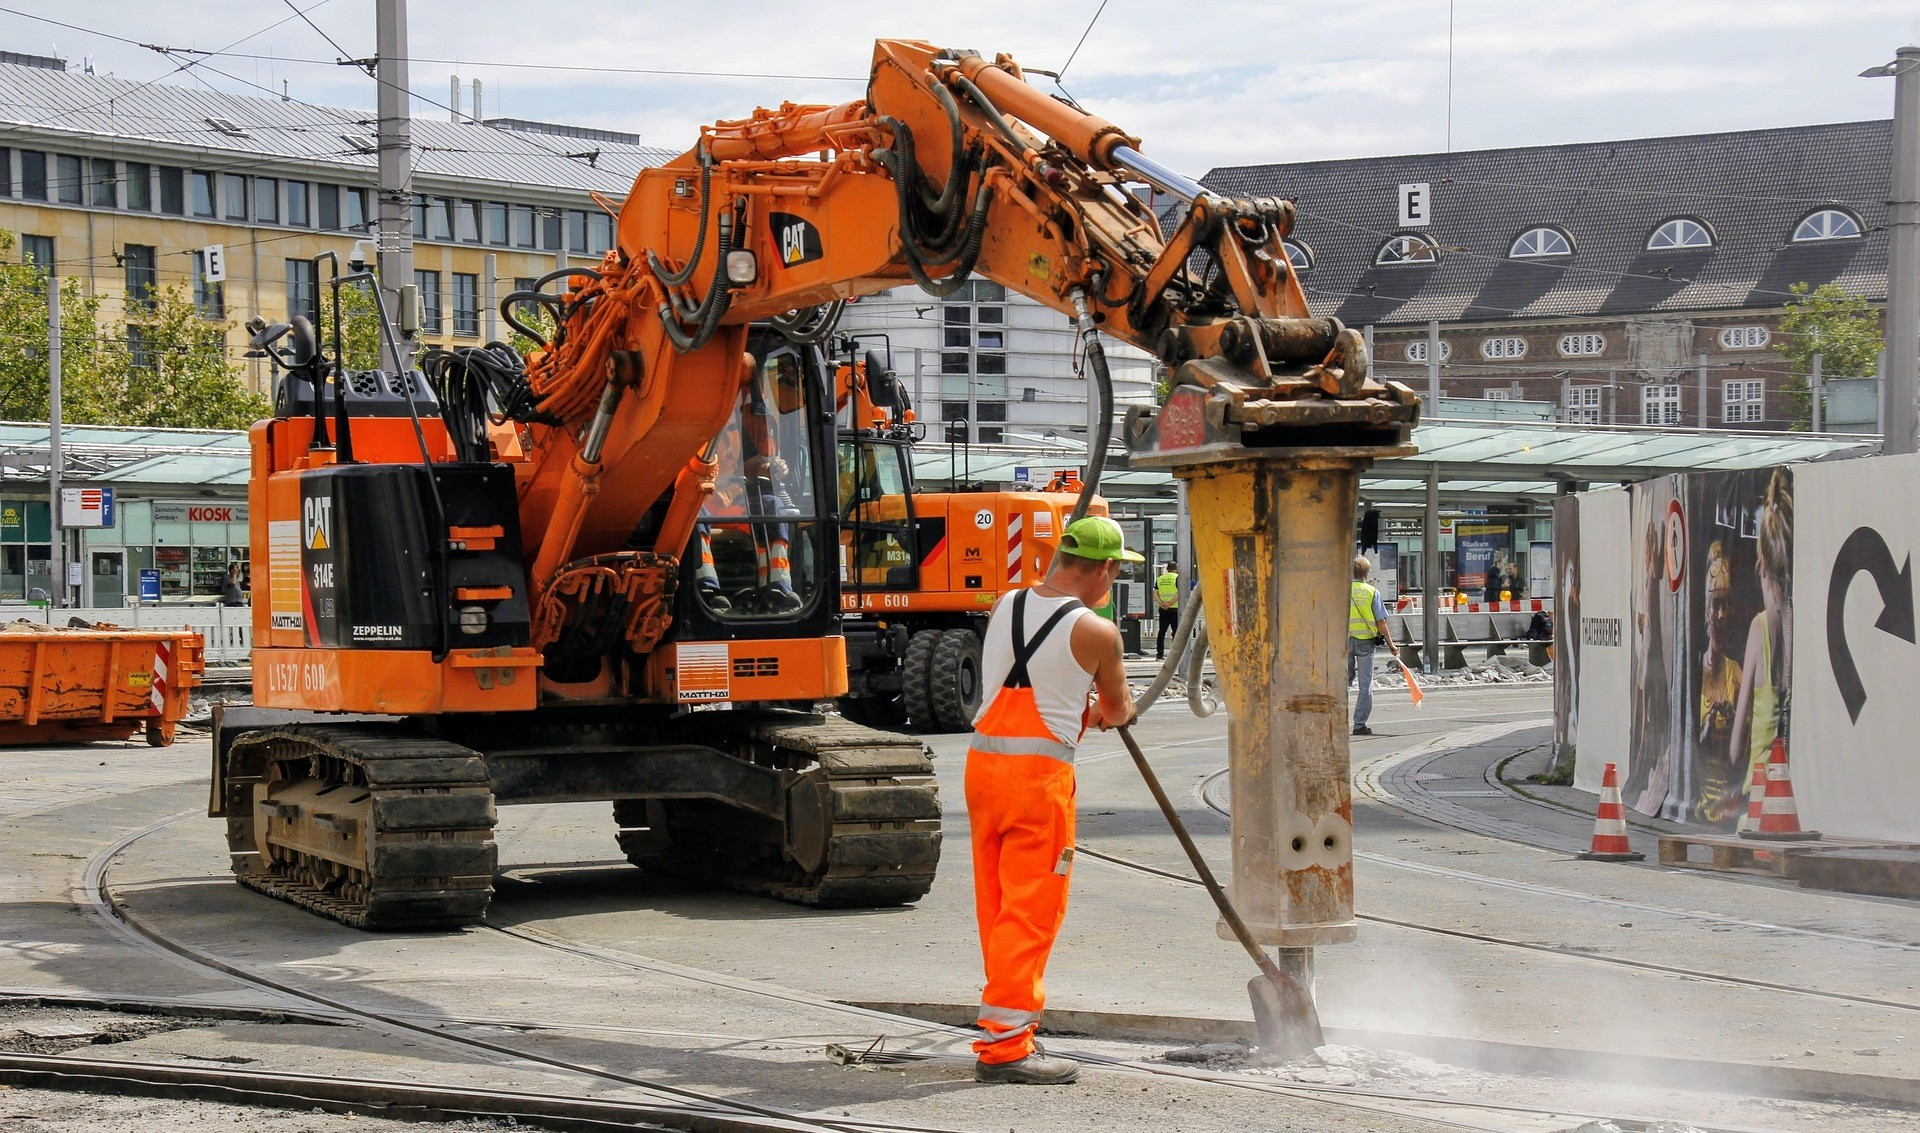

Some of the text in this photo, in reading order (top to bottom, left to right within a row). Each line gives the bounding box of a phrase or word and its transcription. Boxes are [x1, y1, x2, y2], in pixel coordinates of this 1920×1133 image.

[1408, 191, 1421, 219] E
[783, 222, 805, 264] CAT
[210, 251, 219, 275] E
[104, 505, 109, 516] F
[188, 507, 232, 522] KIOSK
[977, 513, 992, 525] 20
[304, 496, 331, 550] CAT
[1465, 552, 1491, 561] Beruf
[313, 563, 334, 589] 314E
[884, 594, 909, 608] 600
[353, 625, 402, 636] ZEPPELIN
[269, 664, 325, 691] L1527 600
